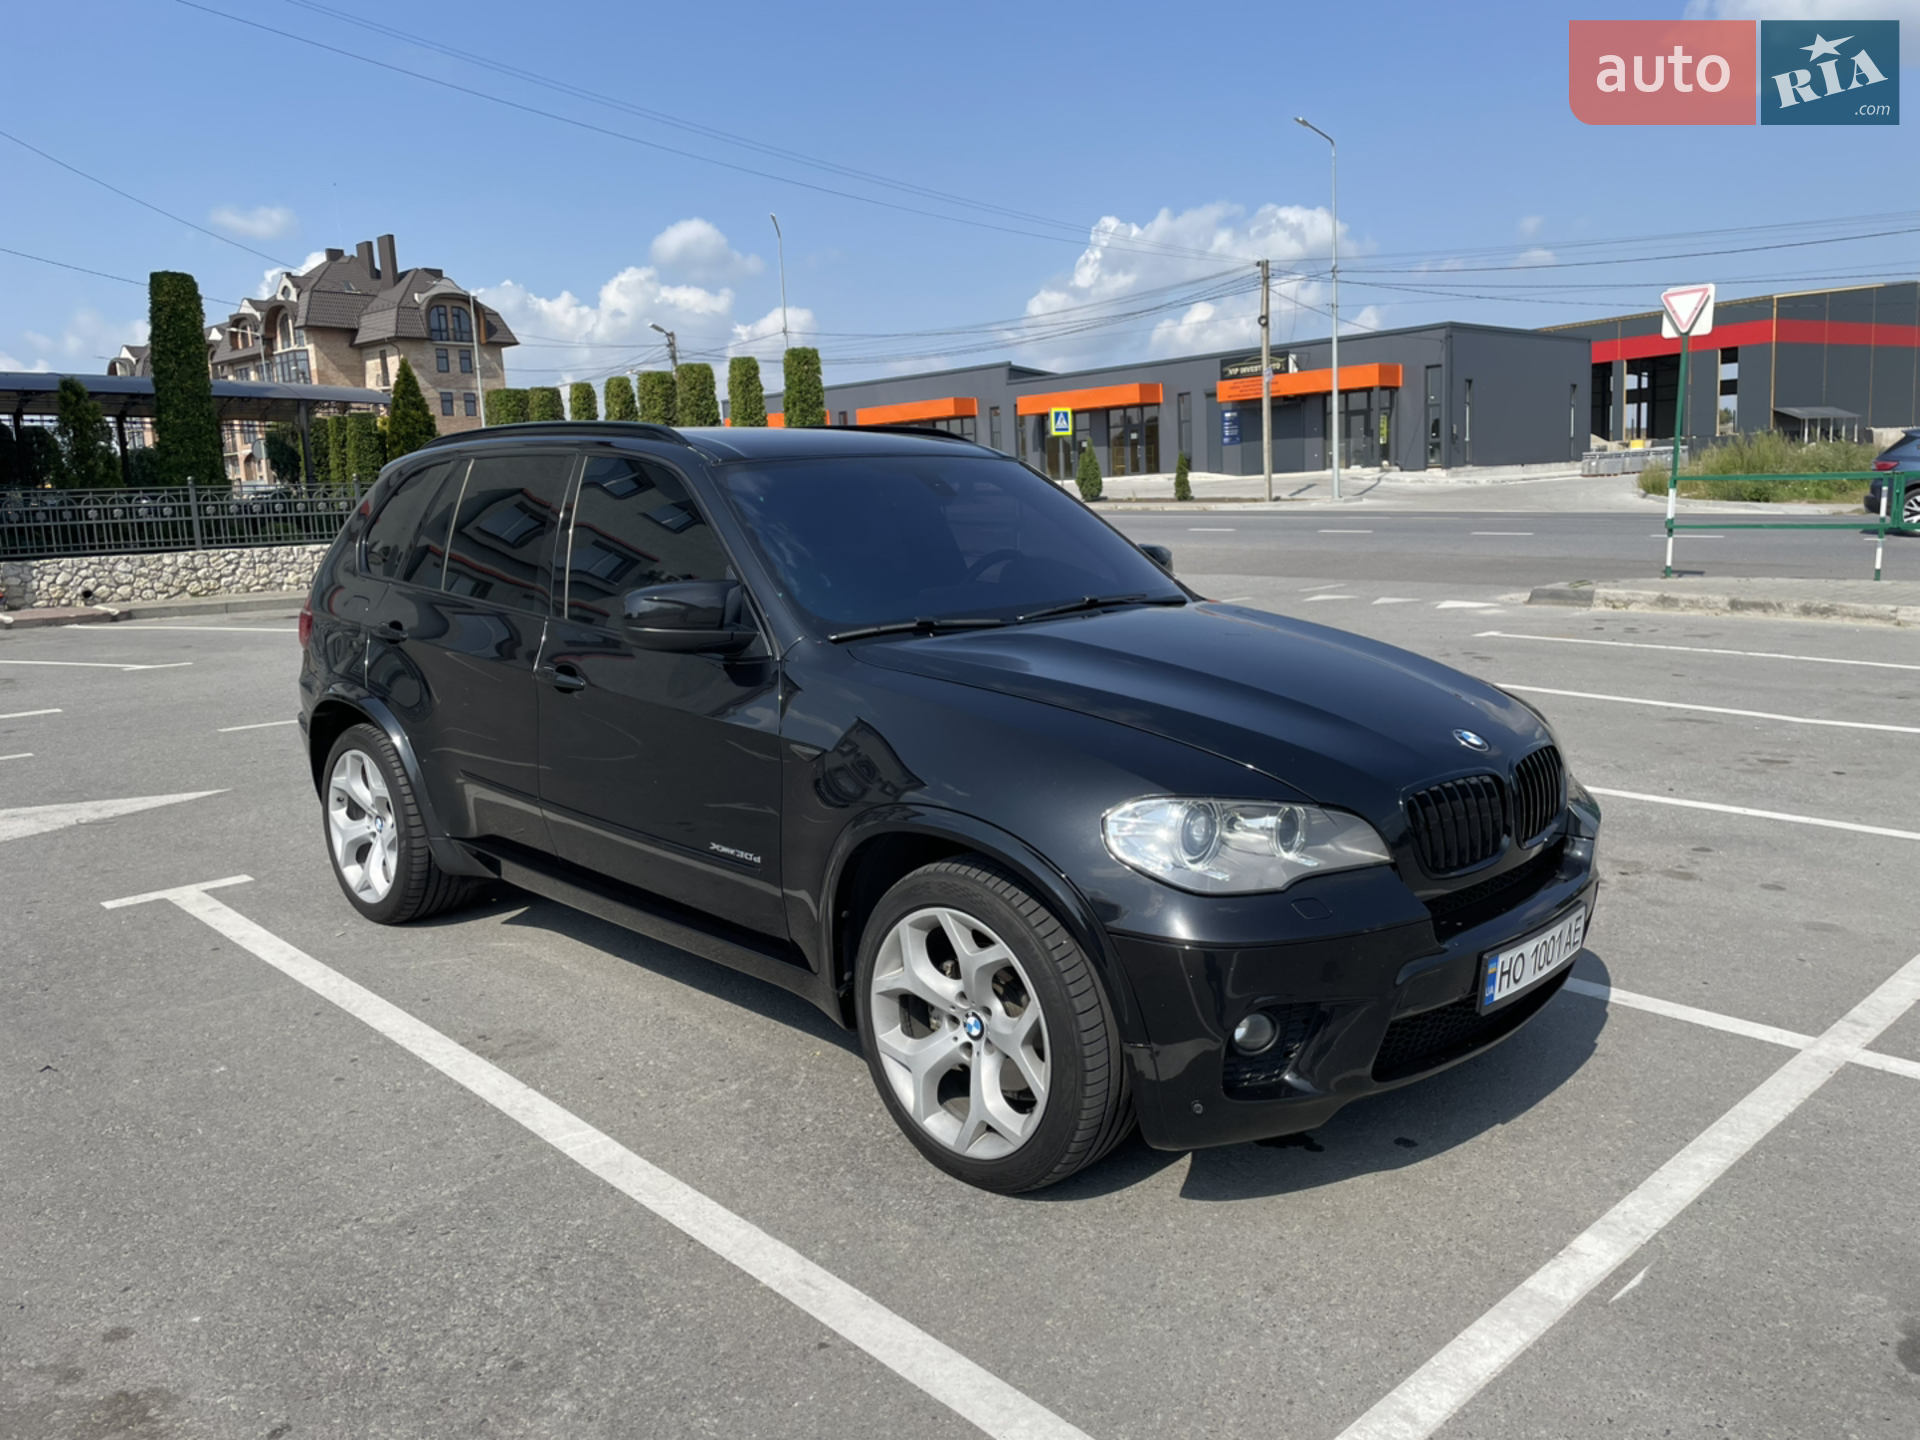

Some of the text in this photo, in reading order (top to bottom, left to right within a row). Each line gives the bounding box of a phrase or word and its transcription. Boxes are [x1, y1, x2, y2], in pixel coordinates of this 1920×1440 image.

[1498, 915, 1583, 993] HO 1001 AE
